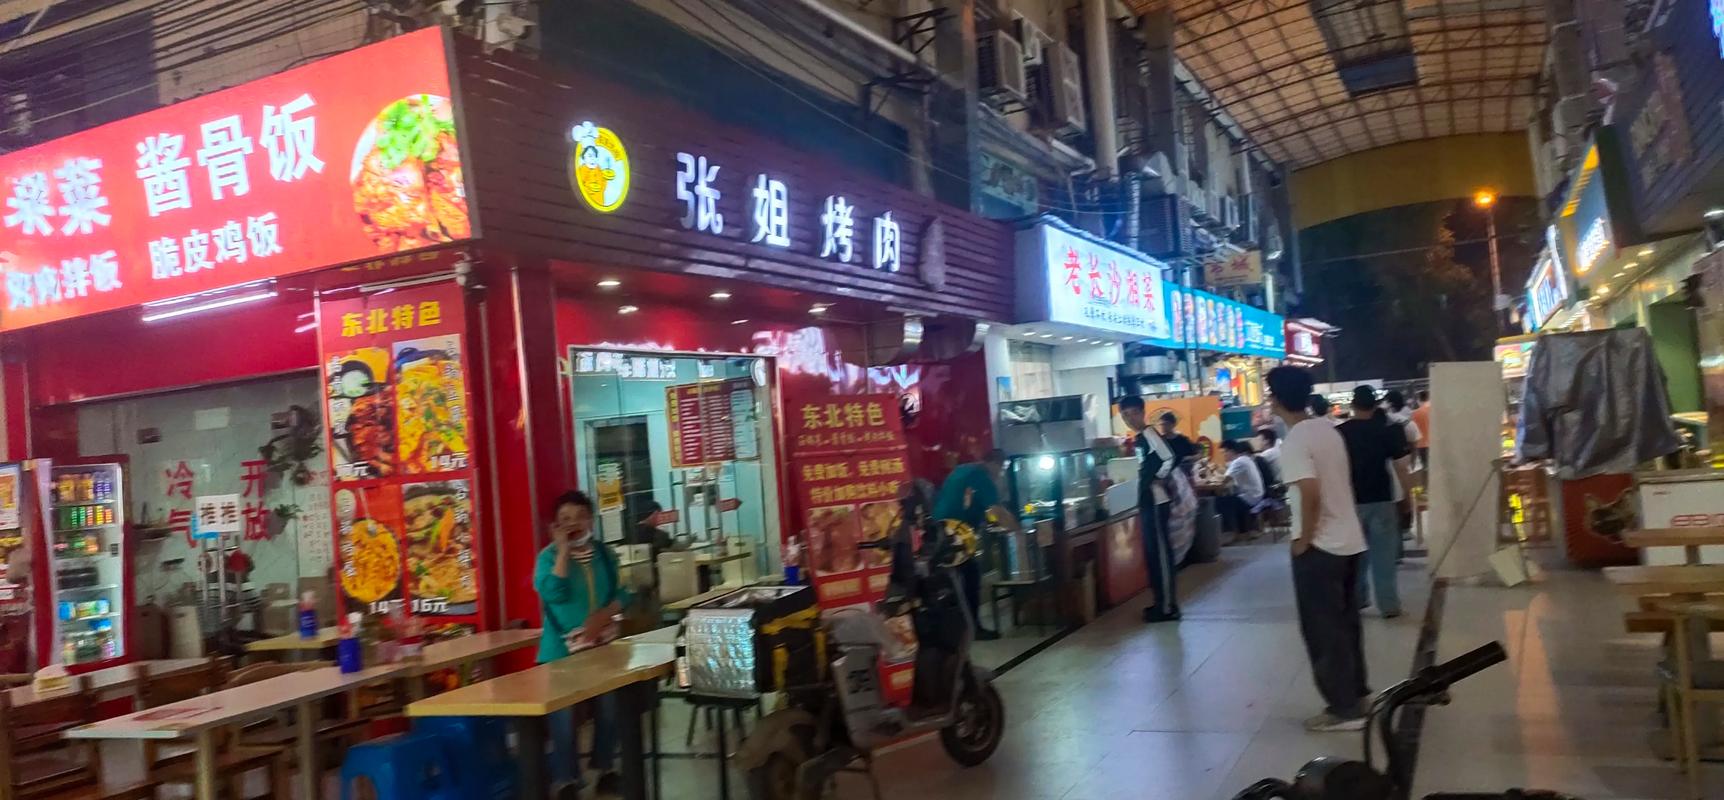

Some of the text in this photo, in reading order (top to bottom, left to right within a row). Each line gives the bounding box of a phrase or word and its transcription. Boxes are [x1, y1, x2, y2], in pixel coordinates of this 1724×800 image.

[136, 93, 326, 217] 酱骨饭
[148, 212, 284, 280] 脆皮鸡饭
[676, 152, 901, 273] 张姐烤肉
[341, 300, 441, 337] 东北特色
[801, 402, 885, 430] 东北特色
[240, 460, 273, 541] 开放
